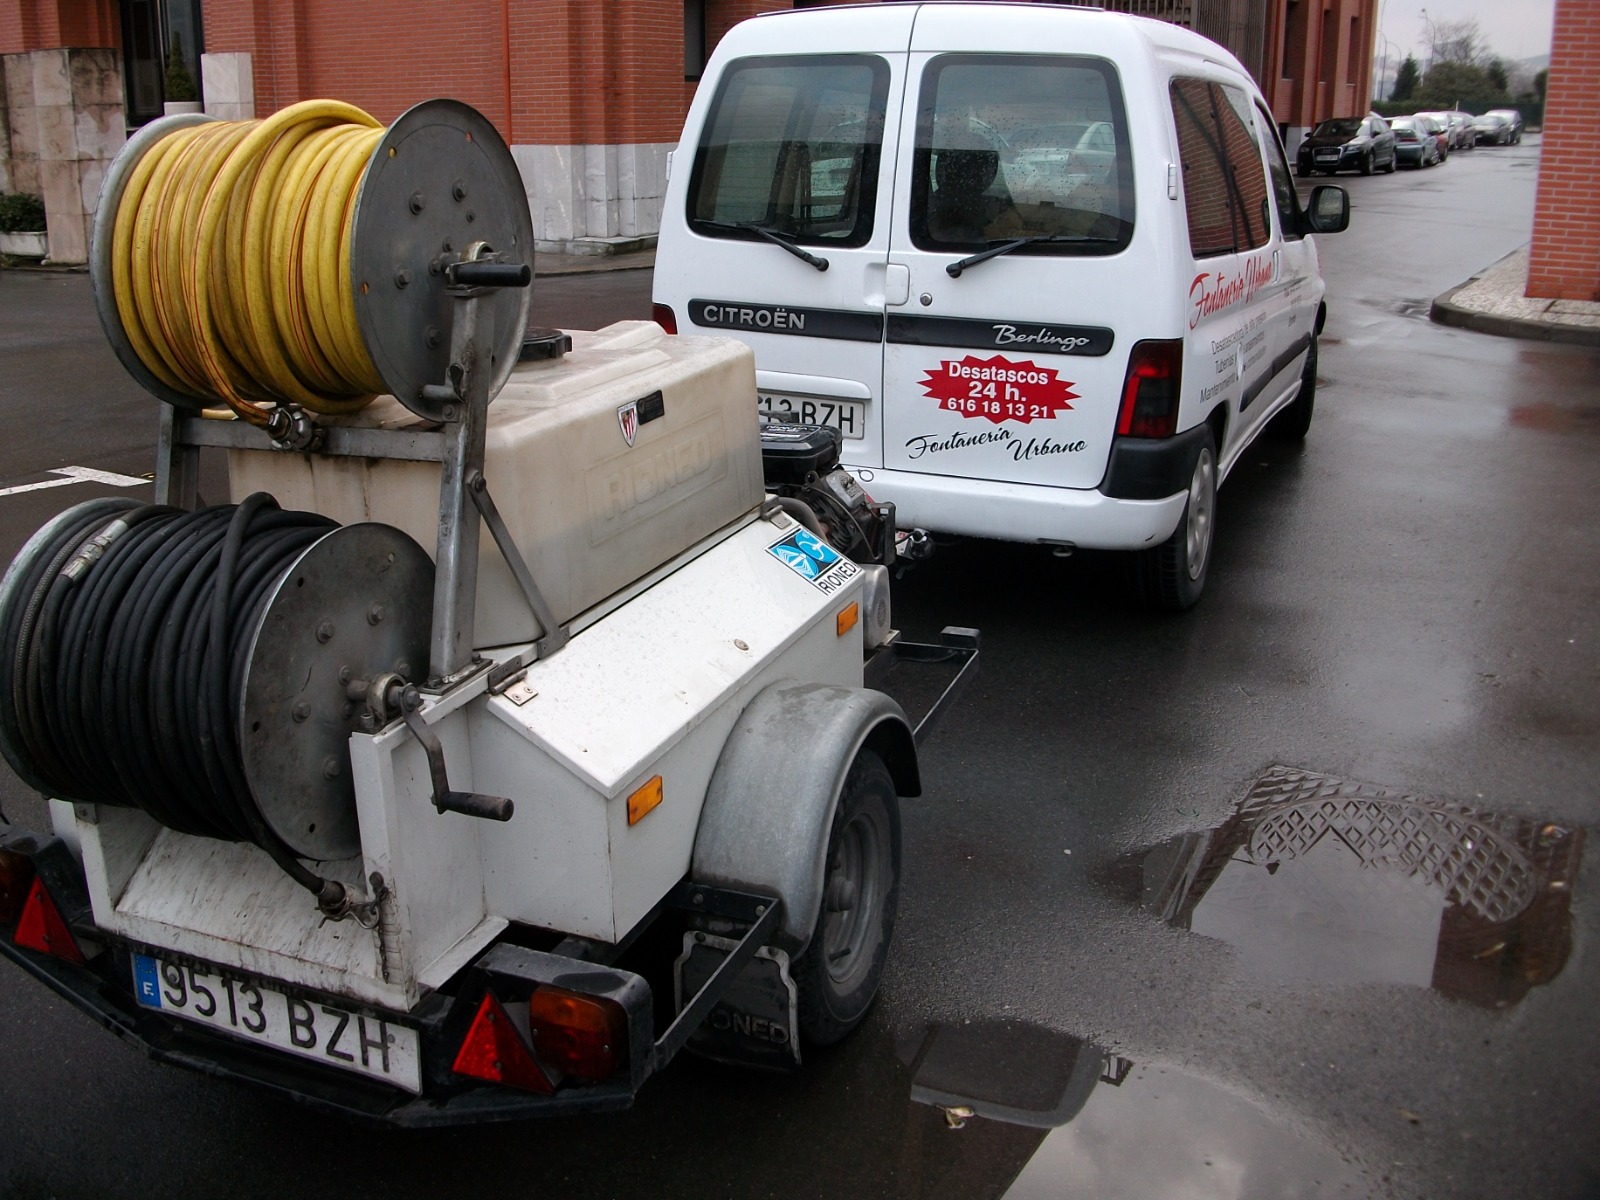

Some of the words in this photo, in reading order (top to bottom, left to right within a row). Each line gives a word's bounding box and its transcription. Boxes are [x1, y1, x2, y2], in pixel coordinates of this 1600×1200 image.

[703, 305, 805, 330] CITROËN
[992, 324, 1090, 351] Berlingo
[949, 361, 1048, 385] Desatascos
[968, 381, 997, 398] 24
[1005, 383, 1027, 402] h.
[802, 401, 854, 433] BZH
[947, 398, 976, 411] 616
[982, 401, 1000, 414] 18
[1006, 403, 1025, 416] 13
[1030, 405, 1048, 418] 21
[1006, 438, 1088, 462] Urbano
[818, 562, 857, 594] RIONED
[143, 982, 154, 996] E
[161, 961, 267, 1033] 9513
[287, 999, 390, 1073] BZH
